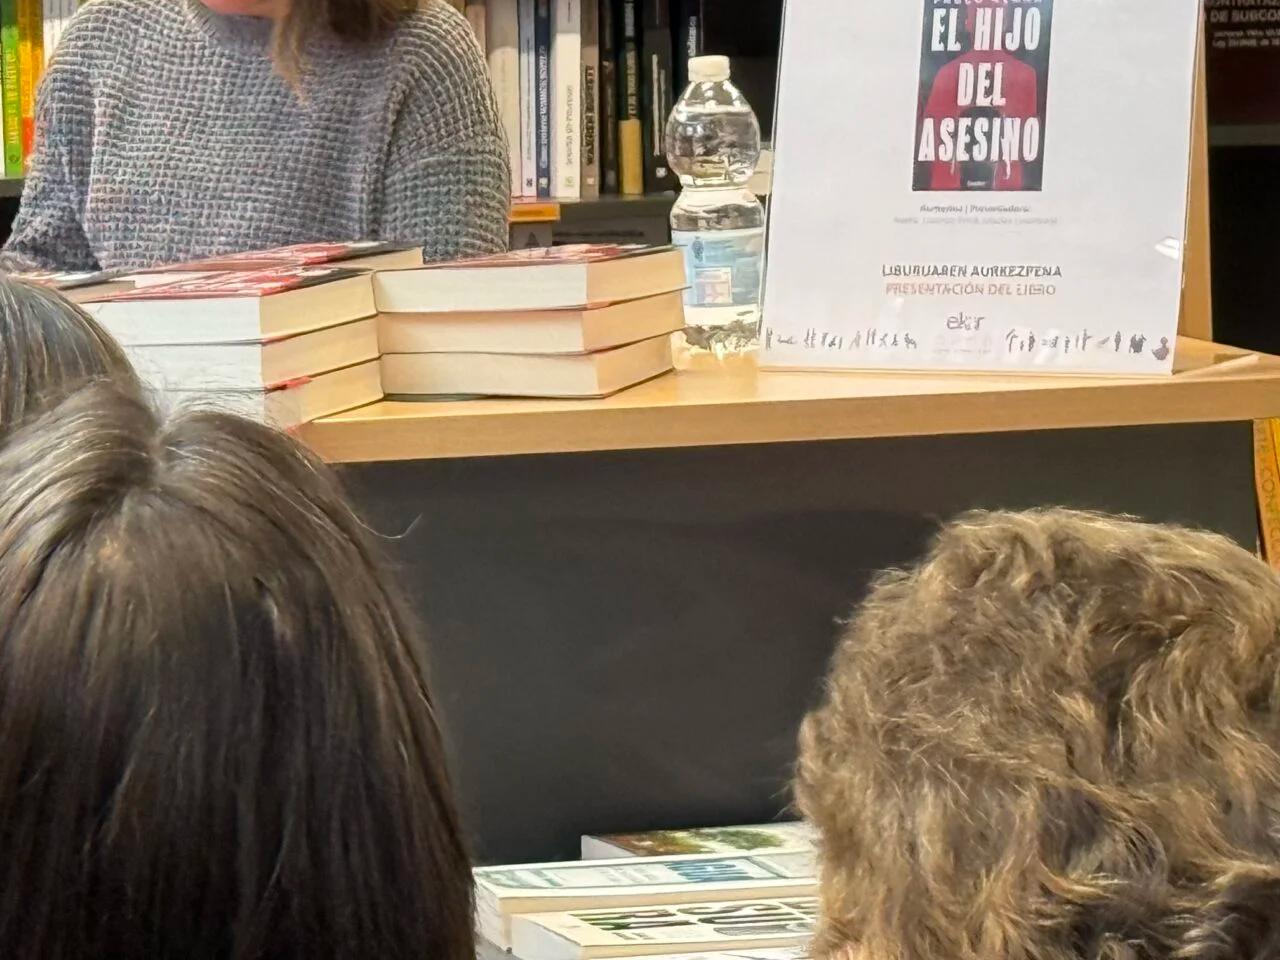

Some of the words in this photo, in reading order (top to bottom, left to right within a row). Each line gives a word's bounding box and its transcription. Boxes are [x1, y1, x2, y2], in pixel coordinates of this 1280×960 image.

[931, 8, 962, 52] EL
[973, 6, 1041, 52] HIJO
[956, 62, 1007, 107] DEL
[917, 117, 1041, 163] ASESINO
[885, 281, 985, 296] PRESENTACIÓN
[988, 282, 1013, 296] DEL
[970, 264, 1062, 278] AURKEZPENA
